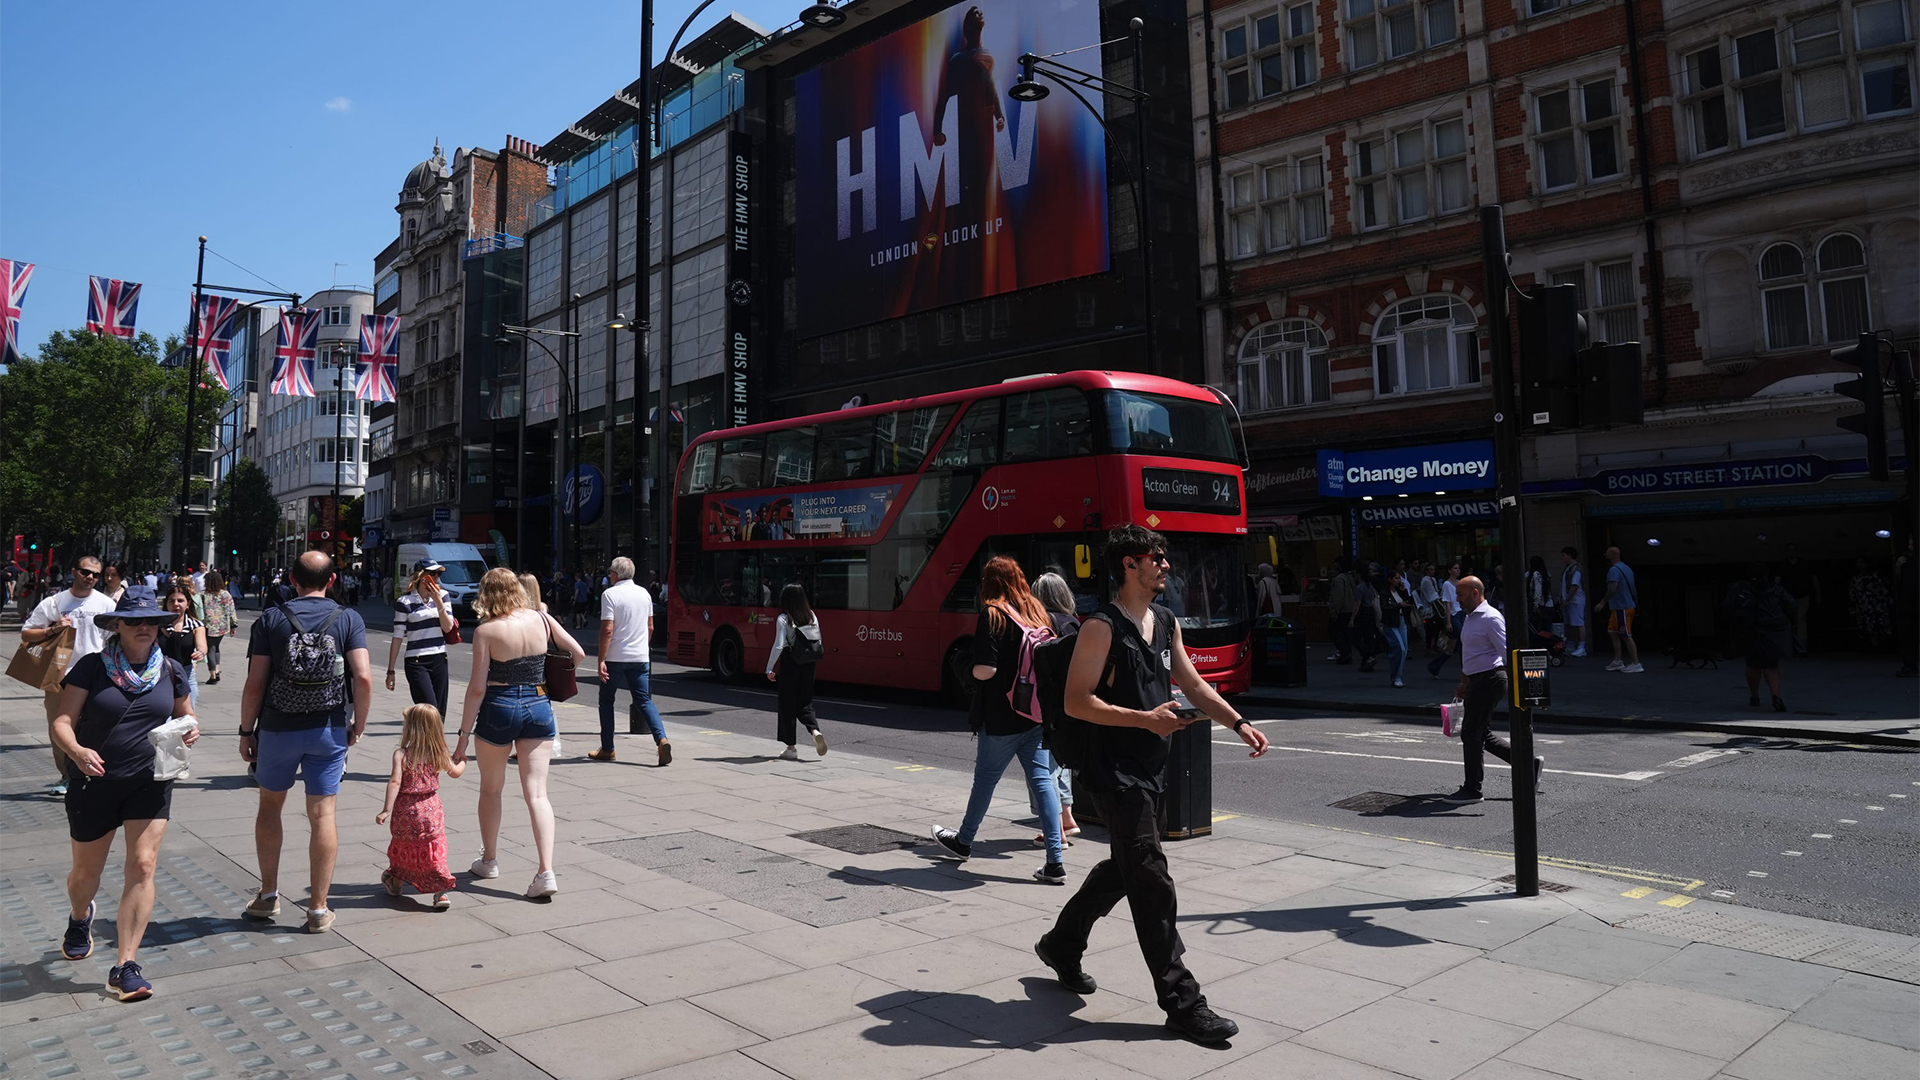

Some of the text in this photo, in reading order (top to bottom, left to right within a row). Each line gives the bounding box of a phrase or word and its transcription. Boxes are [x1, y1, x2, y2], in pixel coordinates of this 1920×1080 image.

[836, 87, 1038, 242] HMV
[734, 154, 748, 252] THE HMV SHOP
[870, 216, 1003, 268] LONDON LOOK UP
[733, 331, 748, 370] SHOP
[733, 371, 748, 404] HMV
[1327, 457, 1345, 471] atm
[1346, 459, 1491, 485] Change Money
[1327, 473, 1345, 483] Change
[1328, 482, 1344, 491] Money
[1607, 462, 1813, 490] BOND STREET STATION
[1144, 476, 1231, 502] Acton Green 94
[800, 496, 836, 506] PLUG INTO
[800, 504, 867, 517] YOUR NEXT CAREER
[1361, 501, 1500, 522] CHANGE MONEY
[868, 627, 903, 642] first bus
[1197, 654, 1218, 663] first bus
[1524, 670, 1545, 679] WAIT
